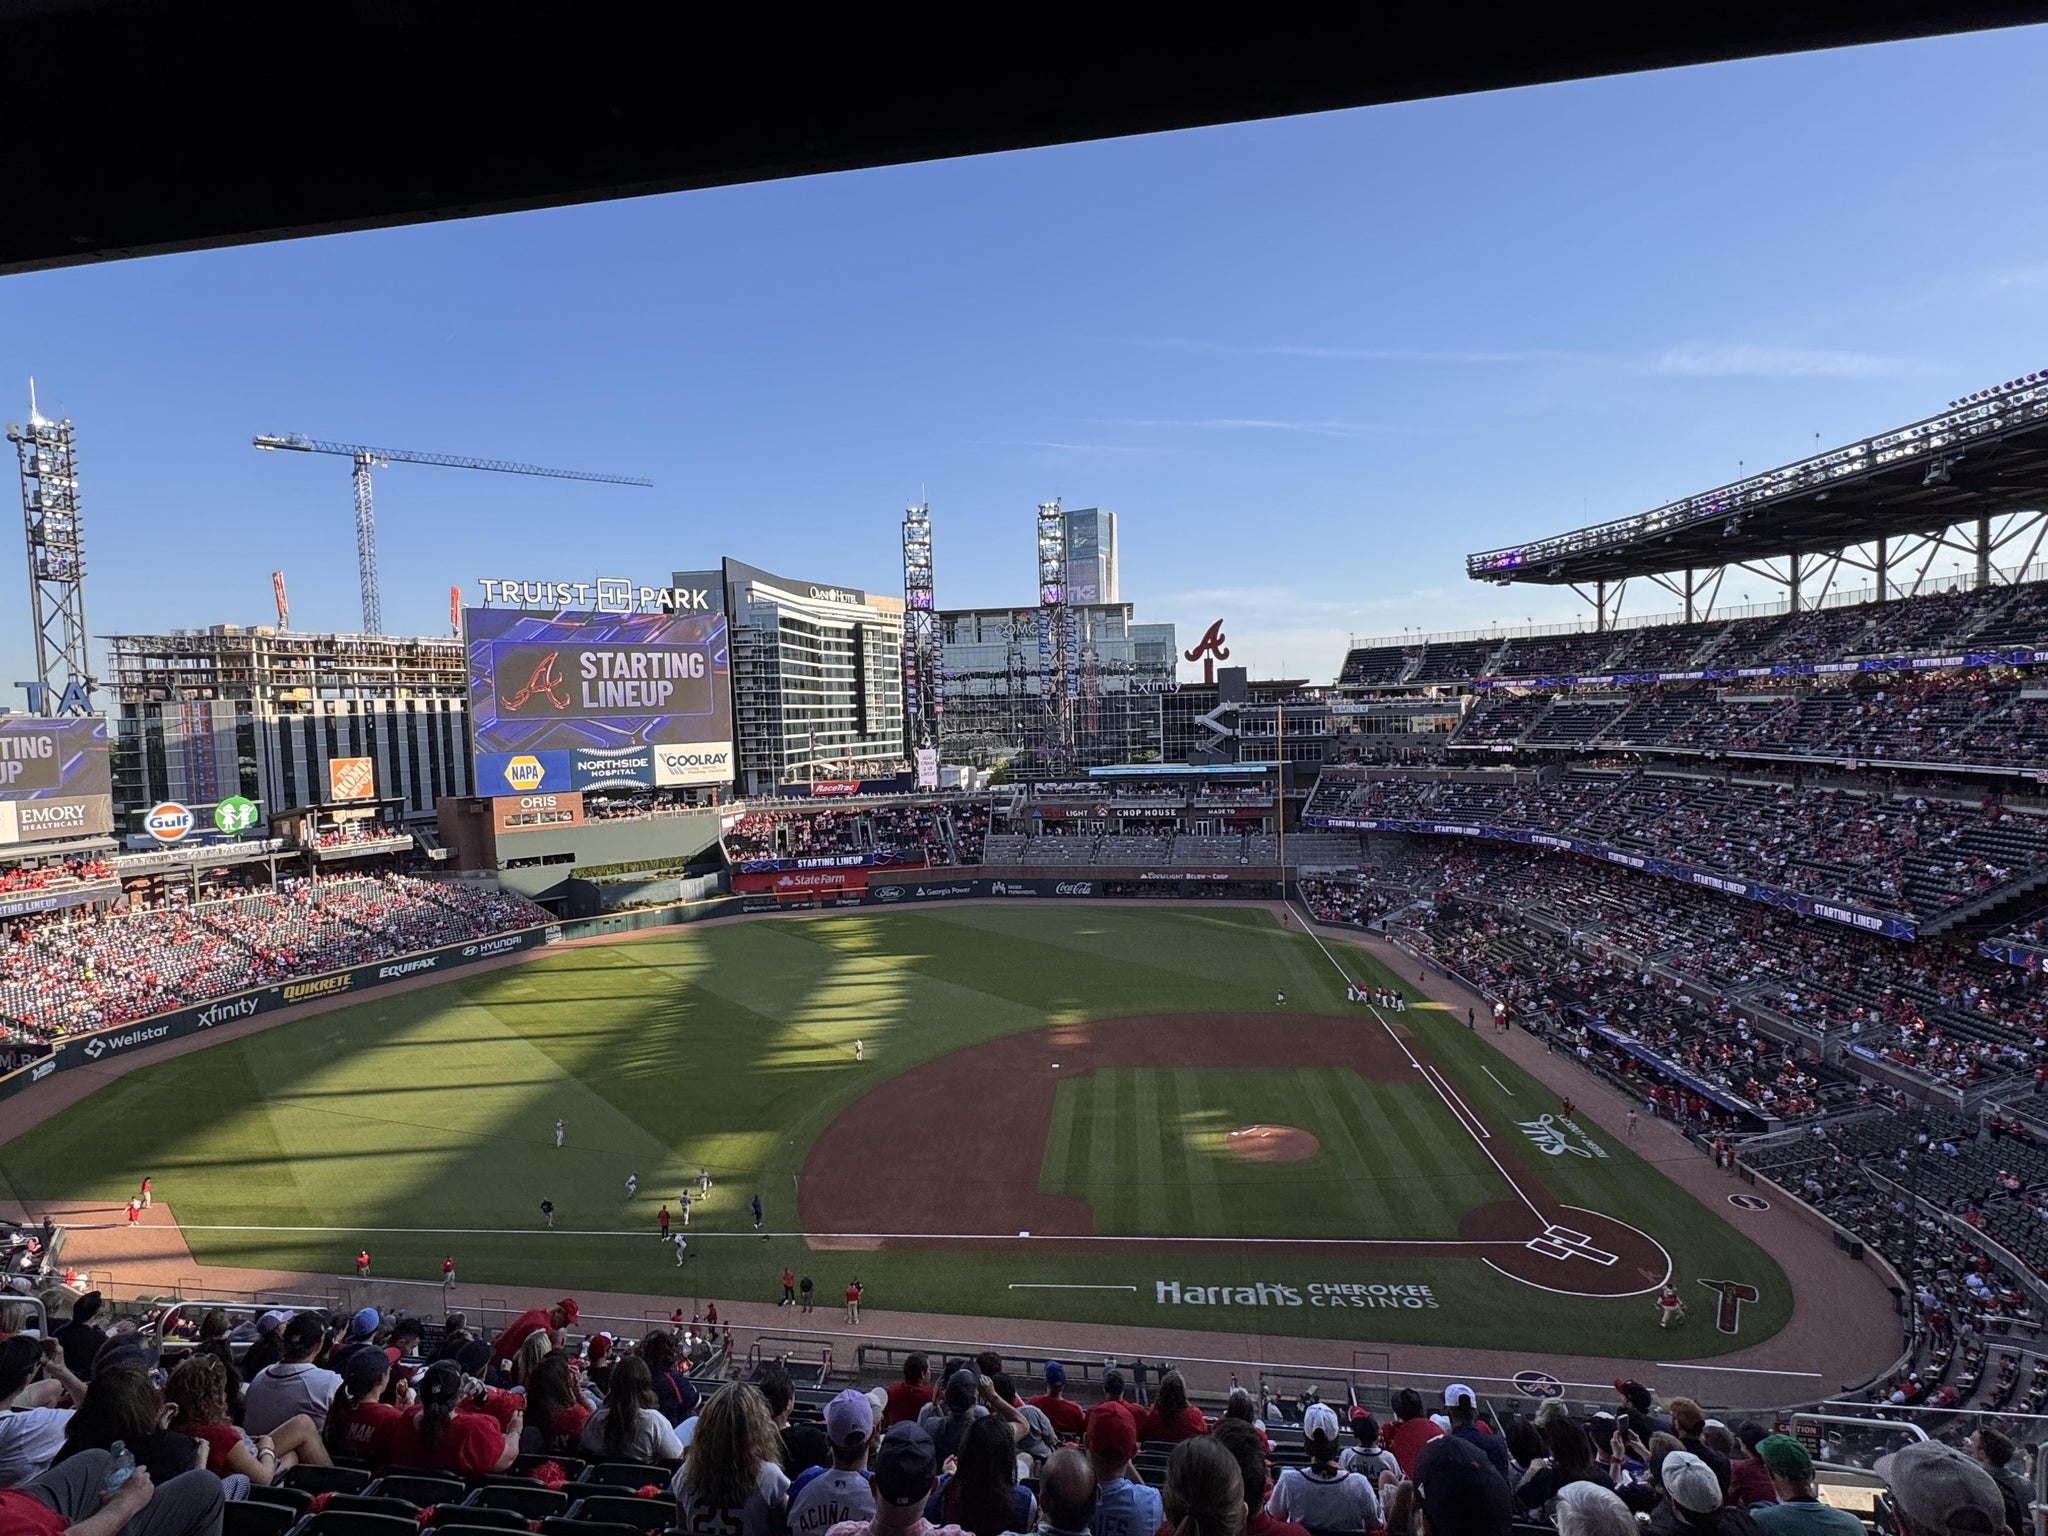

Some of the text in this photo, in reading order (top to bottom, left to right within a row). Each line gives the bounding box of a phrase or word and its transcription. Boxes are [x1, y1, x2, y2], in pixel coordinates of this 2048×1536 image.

[478, 578, 709, 609] TRUIST PARK
[580, 652, 704, 679] STARTING
[1912, 657, 1964, 667] STARTING LINEUP
[1138, 678, 1182, 695] xfinity
[582, 681, 673, 708] LINEUP
[577, 758, 649, 771] NORTHSIDE
[666, 753, 728, 767] COOLRAY
[333, 759, 370, 798] HOME
[511, 766, 539, 780] NAPA
[591, 769, 637, 777] HOSPITAL
[815, 783, 855, 793] RaceTrac
[520, 796, 557, 808] ORIS
[20, 805, 86, 823] EMORY
[1066, 809, 1088, 818] LIGHT
[1116, 808, 1177, 817] CHOP HOUSE
[23, 819, 85, 831] HEALTHCARE
[150, 815, 190, 828] Gulf
[1328, 819, 1356, 828] STARTING
[797, 856, 864, 868] STARTING LINEUP
[1693, 872, 1747, 894] STARTING LINEUP
[880, 888, 900, 897] Ford
[926, 886, 971, 896] Georgia Power
[25, 898, 58, 910] LINEUP
[1814, 903, 1883, 931] STARTING LINEUP
[480, 936, 522, 952] HYUNDAI
[379, 956, 437, 978] EQUIFAX
[283, 974, 352, 999] QUIKRETE
[198, 998, 259, 1027] xfinity
[109, 1025, 170, 1049] Wellstar
[1155, 1281, 1433, 1307] Harrah's CHEROKEE
[1310, 1296, 1440, 1309] CASINOS
[1779, 1424, 1817, 1434] CATION
